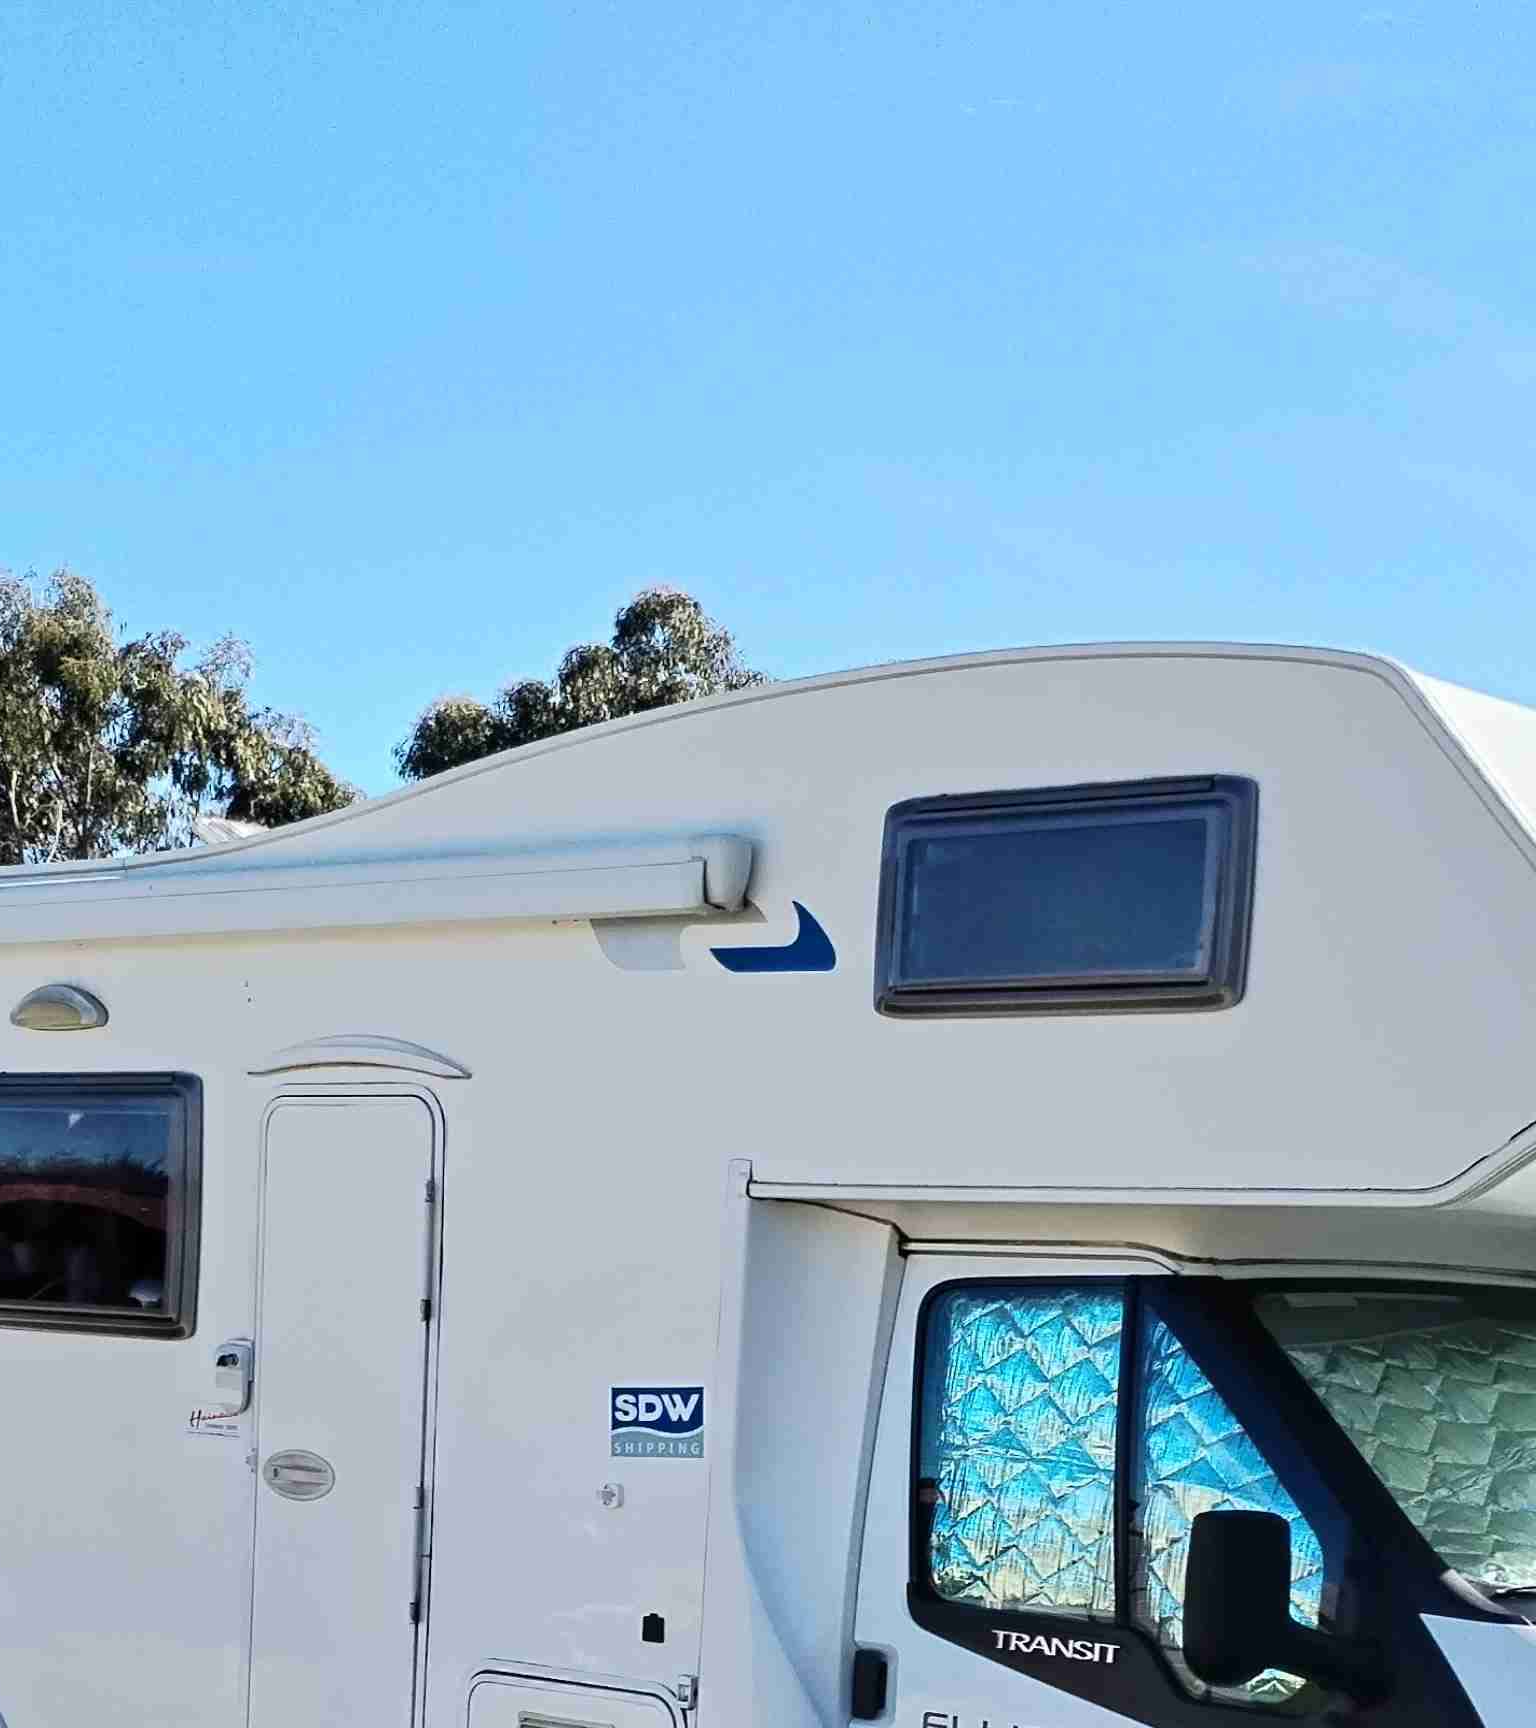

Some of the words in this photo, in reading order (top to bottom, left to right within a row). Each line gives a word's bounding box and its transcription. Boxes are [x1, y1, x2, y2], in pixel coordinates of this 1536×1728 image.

[614, 1394, 700, 1422] SDW
[614, 1442, 701, 1455] SHIPPING
[992, 1630, 1120, 1664] TRANSIT
